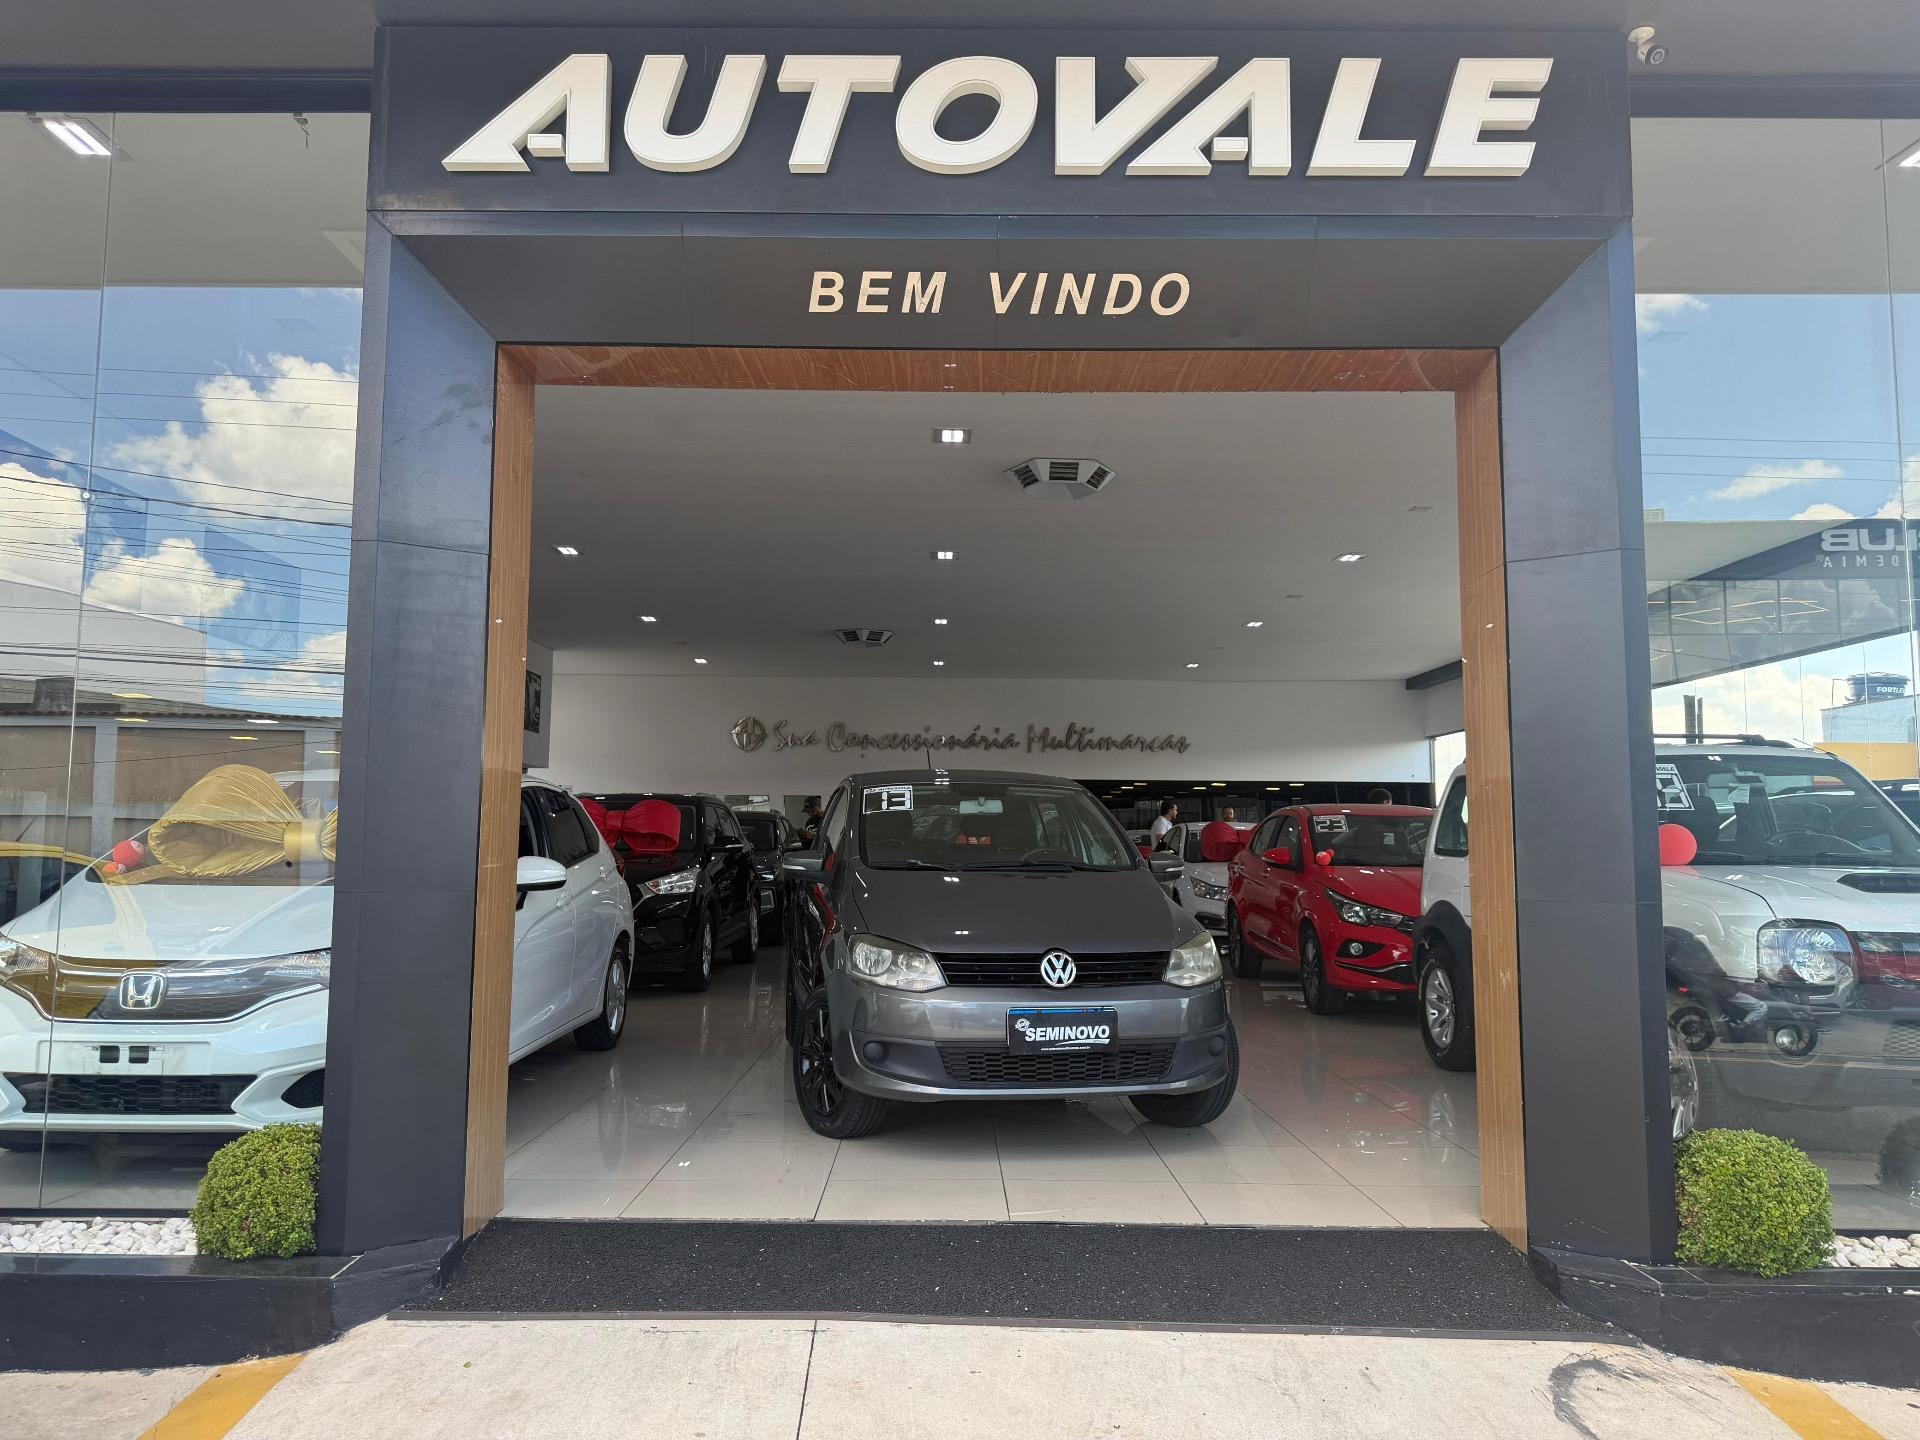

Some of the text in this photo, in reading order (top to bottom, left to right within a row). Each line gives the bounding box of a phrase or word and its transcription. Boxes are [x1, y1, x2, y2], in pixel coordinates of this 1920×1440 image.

[440, 53, 1554, 178] AUTOVALE
[808, 271, 1190, 316] BEM VINDO
[773, 719, 1191, 753] Sua Concessionária Multimarcas
[881, 791, 911, 810] 13
[1656, 774, 1690, 808] 9
[1316, 818, 1347, 832] 23
[1025, 1025, 1110, 1041] SEMINOVO
